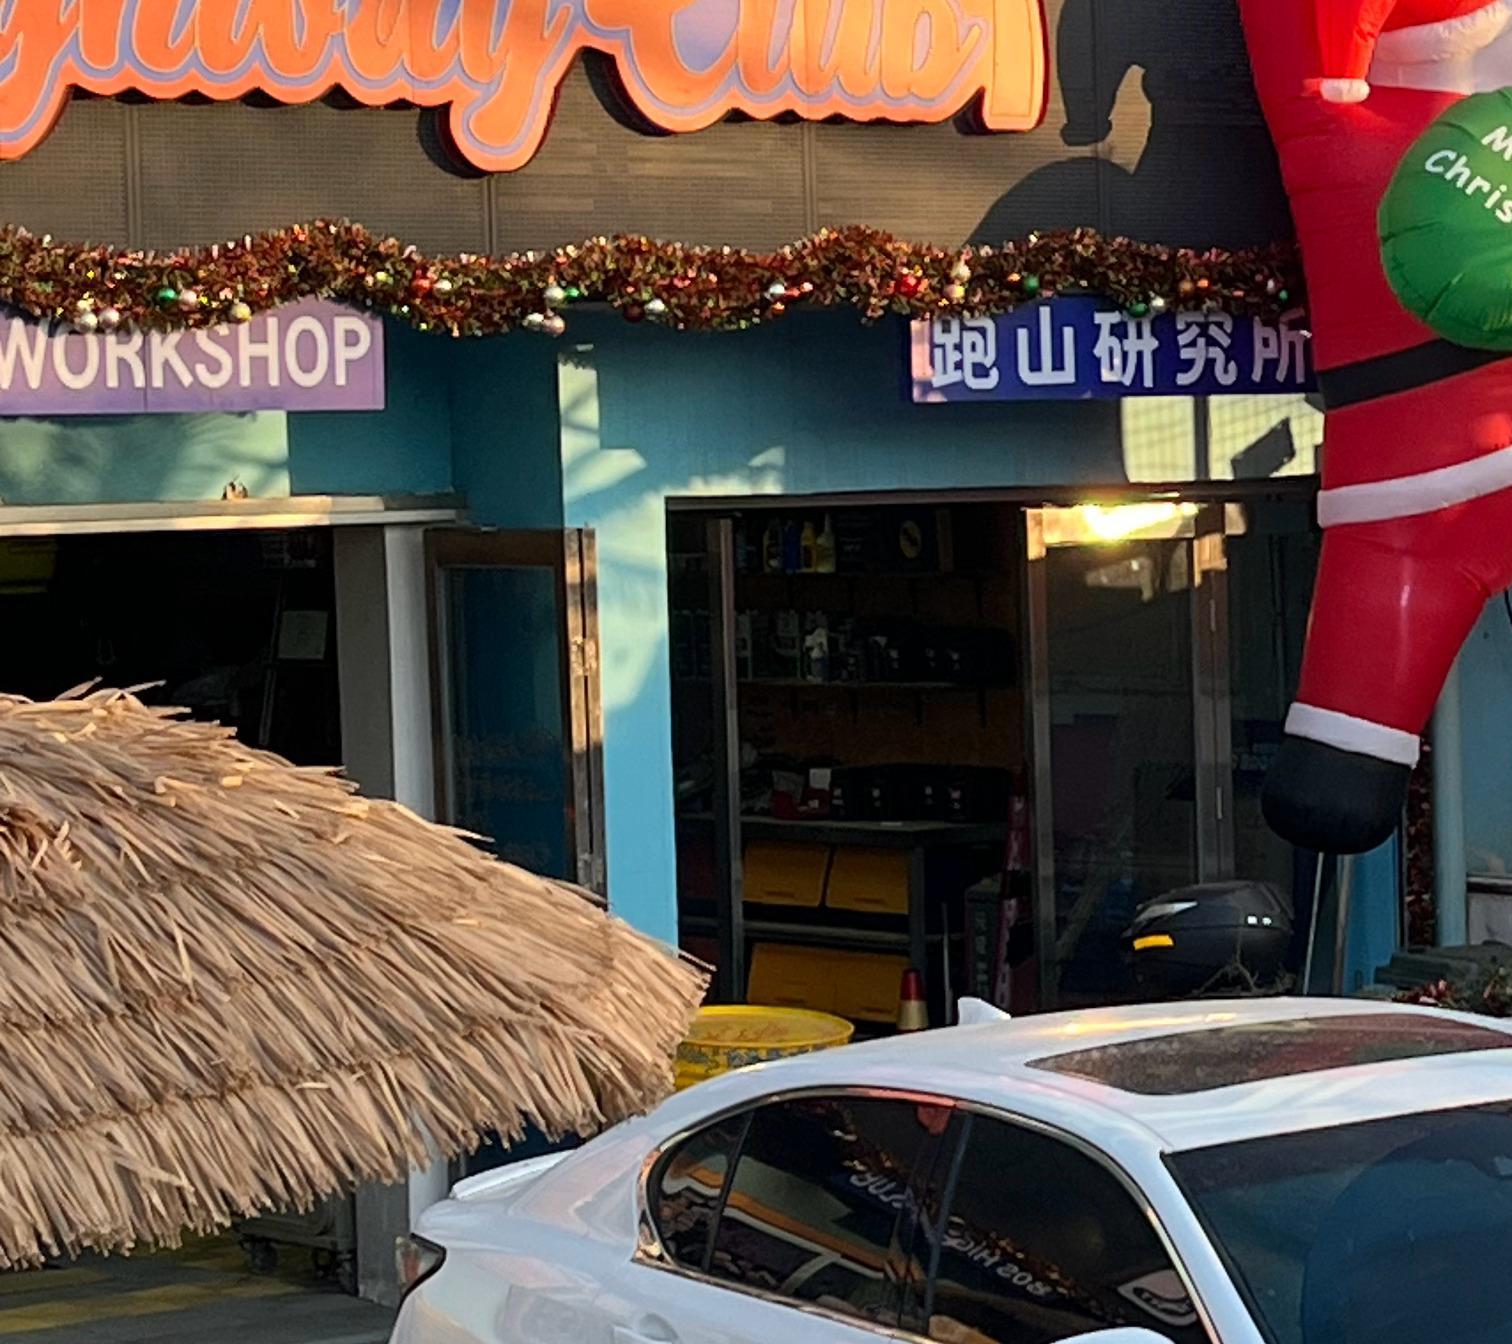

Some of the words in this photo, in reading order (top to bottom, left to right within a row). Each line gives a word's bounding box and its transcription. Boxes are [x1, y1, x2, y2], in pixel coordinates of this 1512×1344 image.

[0, 315, 372, 390] WORKSHOP
[931, 305, 1306, 390] 跑山研究所
